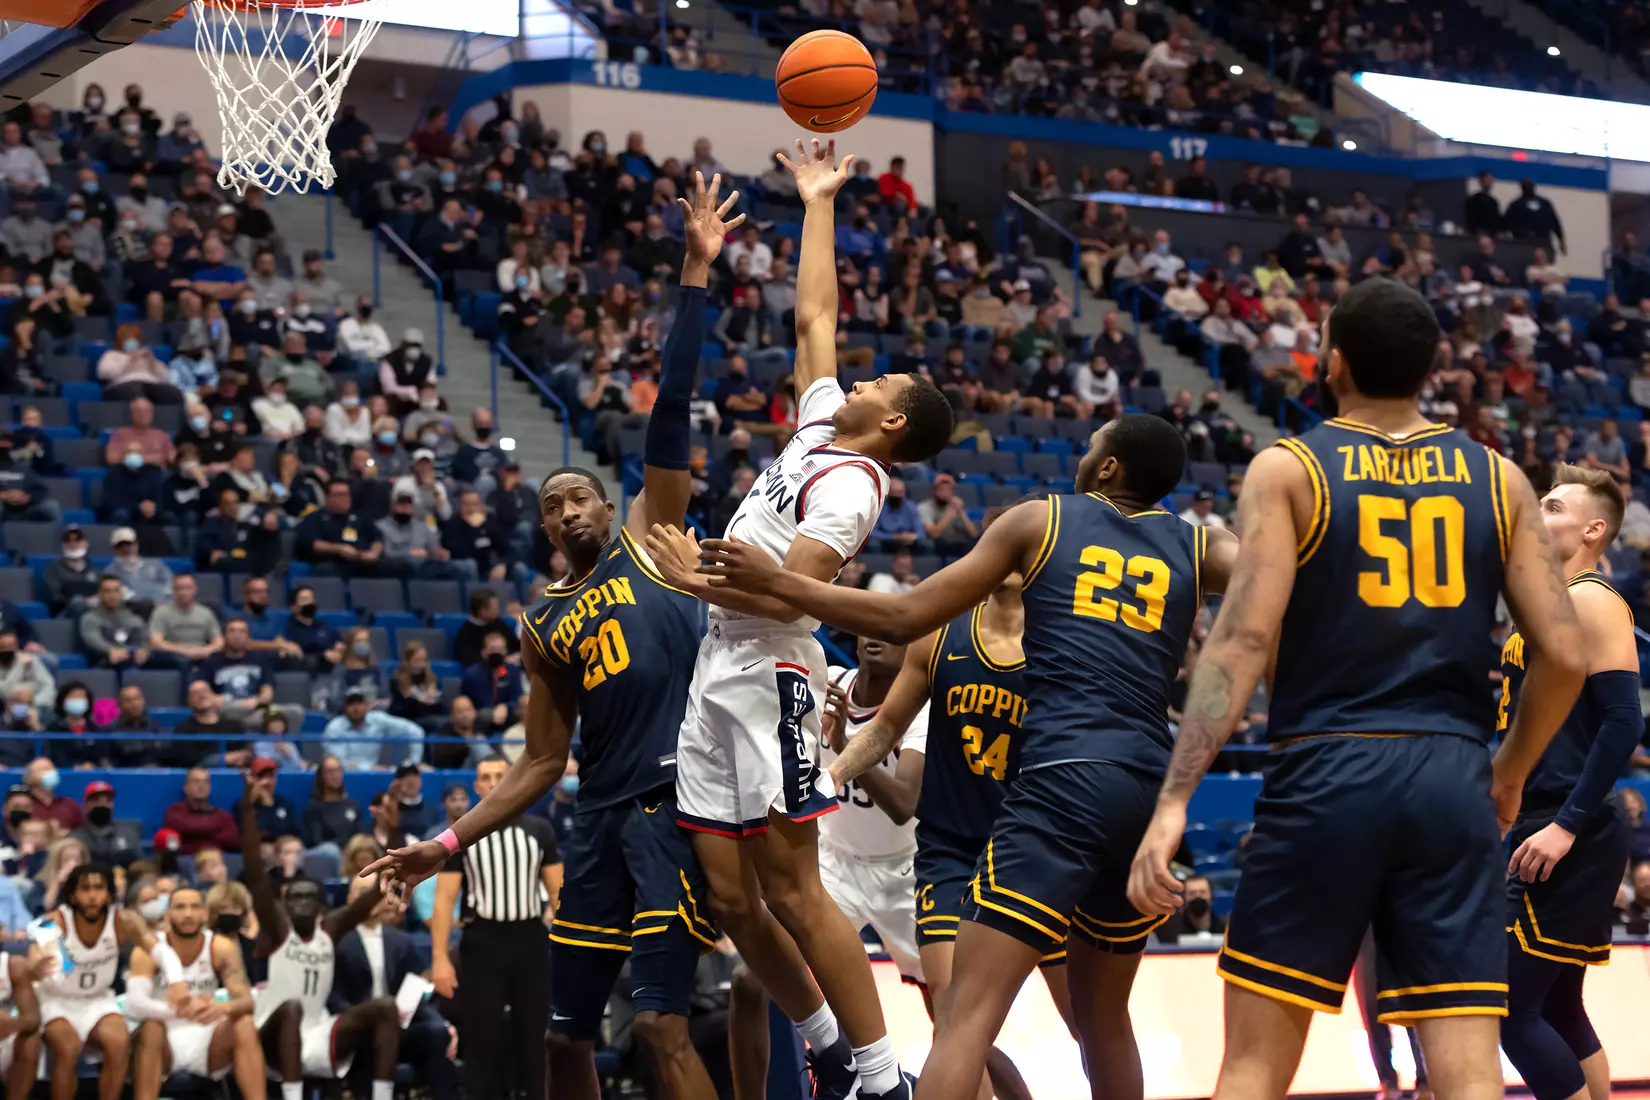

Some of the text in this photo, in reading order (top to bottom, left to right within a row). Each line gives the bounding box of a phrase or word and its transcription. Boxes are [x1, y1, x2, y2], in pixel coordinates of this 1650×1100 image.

[591, 61, 641, 89] 116
[1169, 135, 1208, 161] 117
[1337, 444, 1472, 485] ZARZUELA
[1357, 494, 1467, 608] 50
[1073, 544, 1171, 633] 23
[550, 576, 637, 664] COPPIN
[578, 618, 631, 691] 20
[961, 724, 1011, 781] 24
[303, 967, 321, 996] 11
